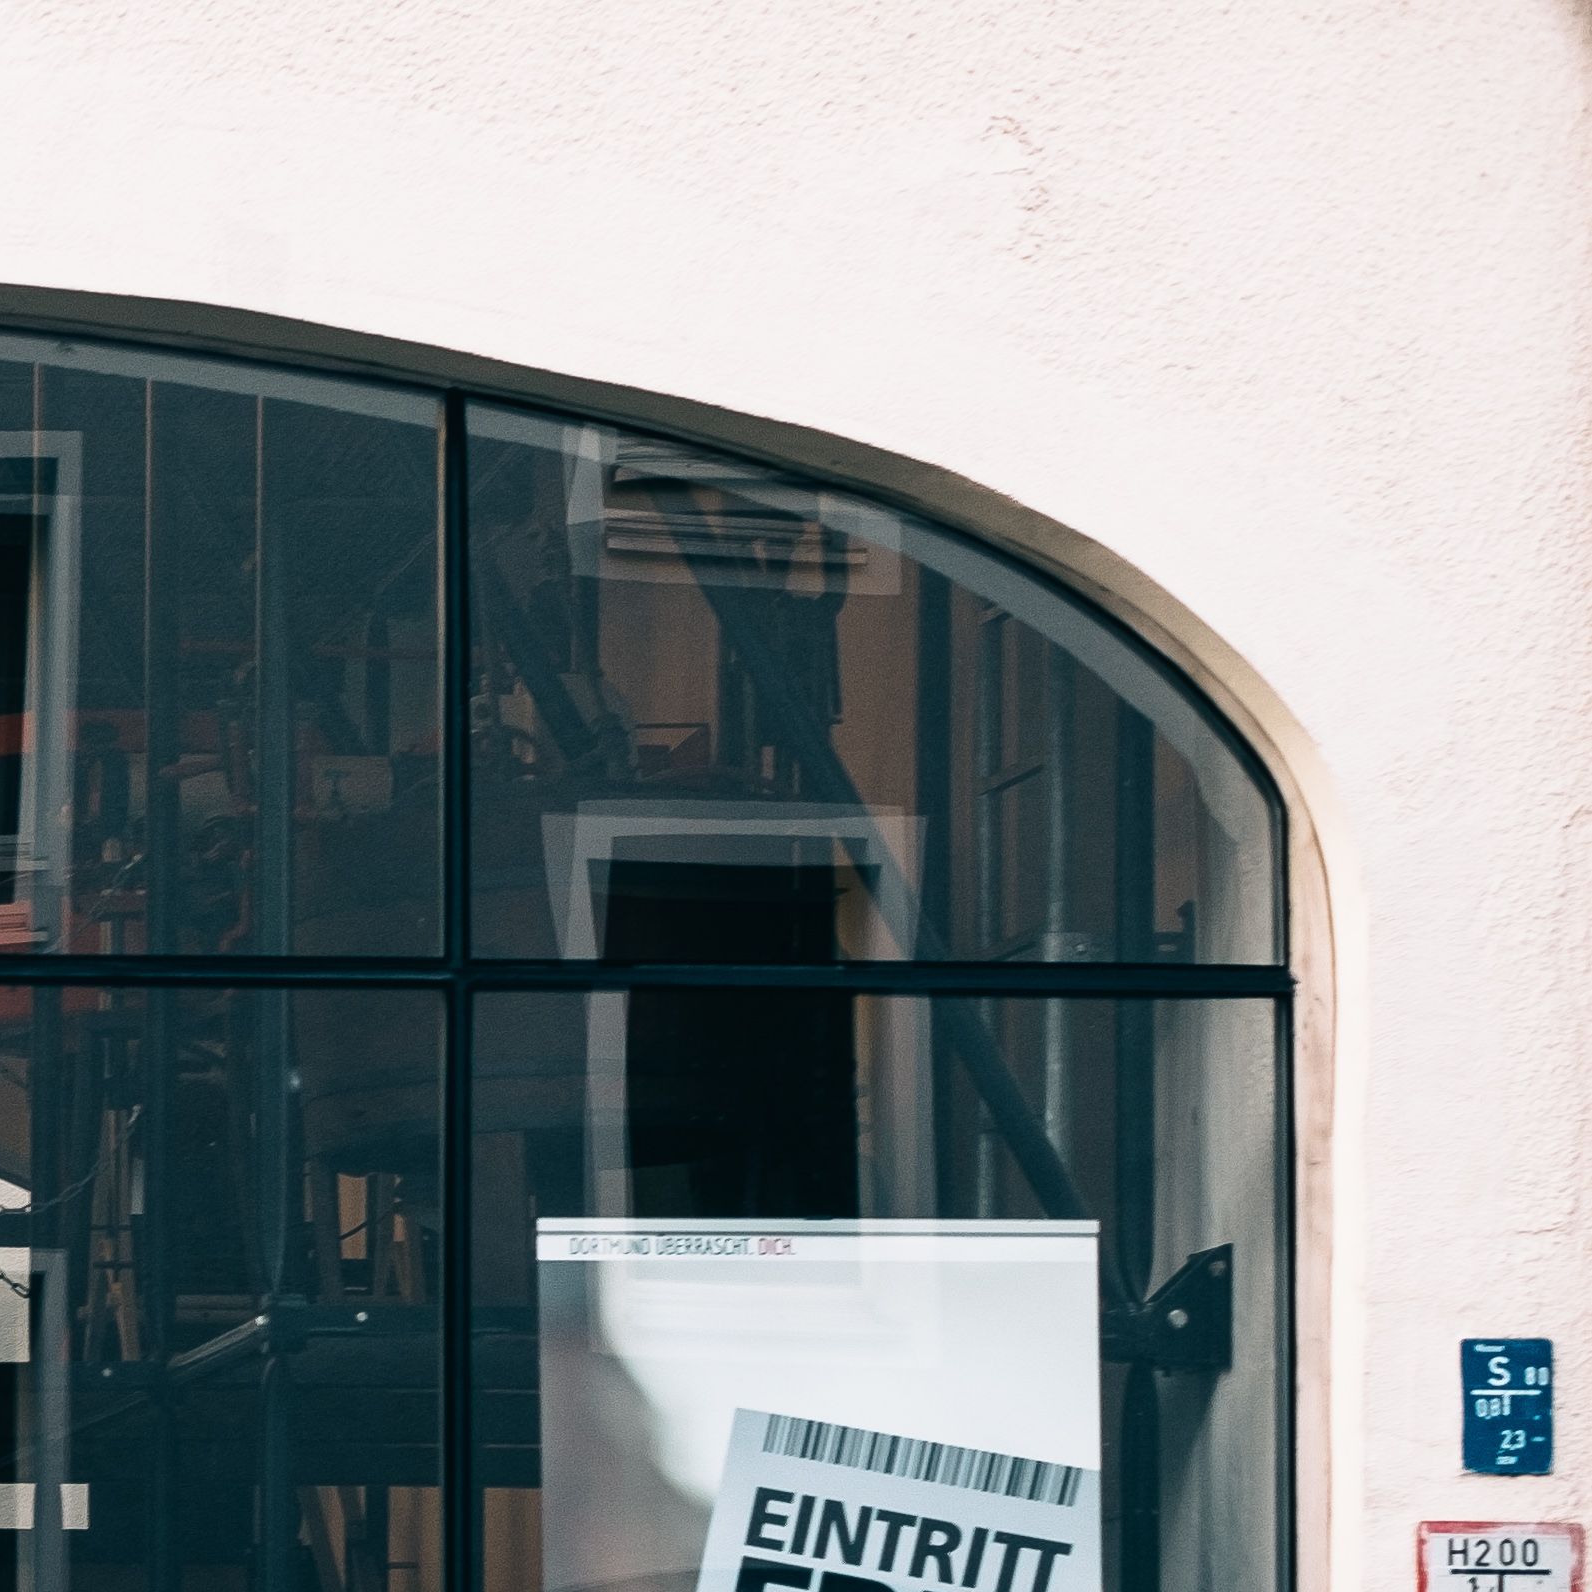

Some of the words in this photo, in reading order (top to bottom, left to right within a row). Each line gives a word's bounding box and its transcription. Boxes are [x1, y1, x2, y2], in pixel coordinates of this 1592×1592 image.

[569, 1236, 650, 1256] DORTMUND
[1486, 1356, 1512, 1386] S
[1447, 1538, 1539, 1567] H200
